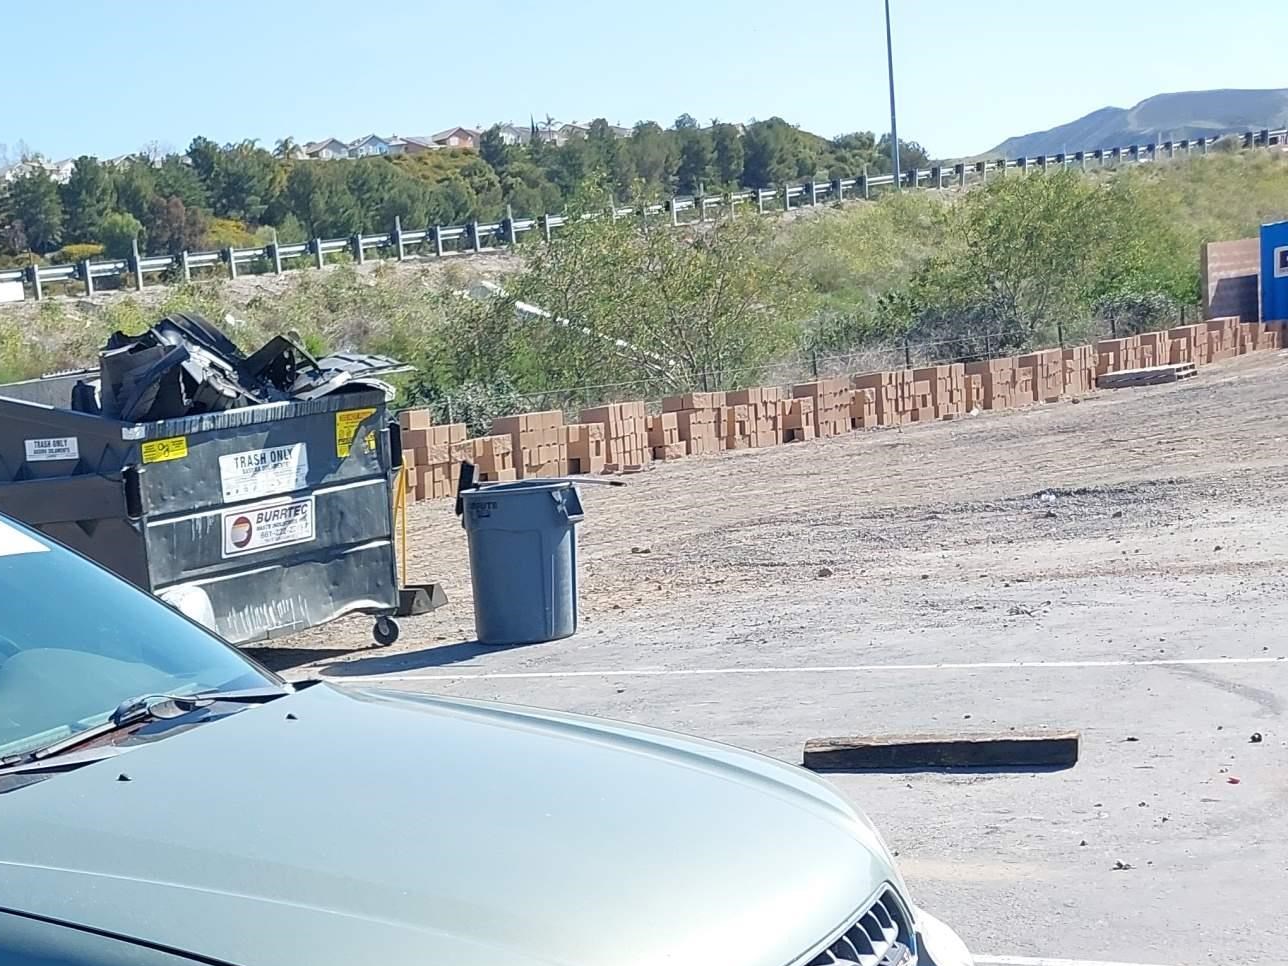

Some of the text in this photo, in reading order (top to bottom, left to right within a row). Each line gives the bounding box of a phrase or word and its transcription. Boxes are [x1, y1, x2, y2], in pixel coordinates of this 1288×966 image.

[234, 448, 292, 469] TRASH ONLY
[256, 503, 308, 524] BURRTEC
